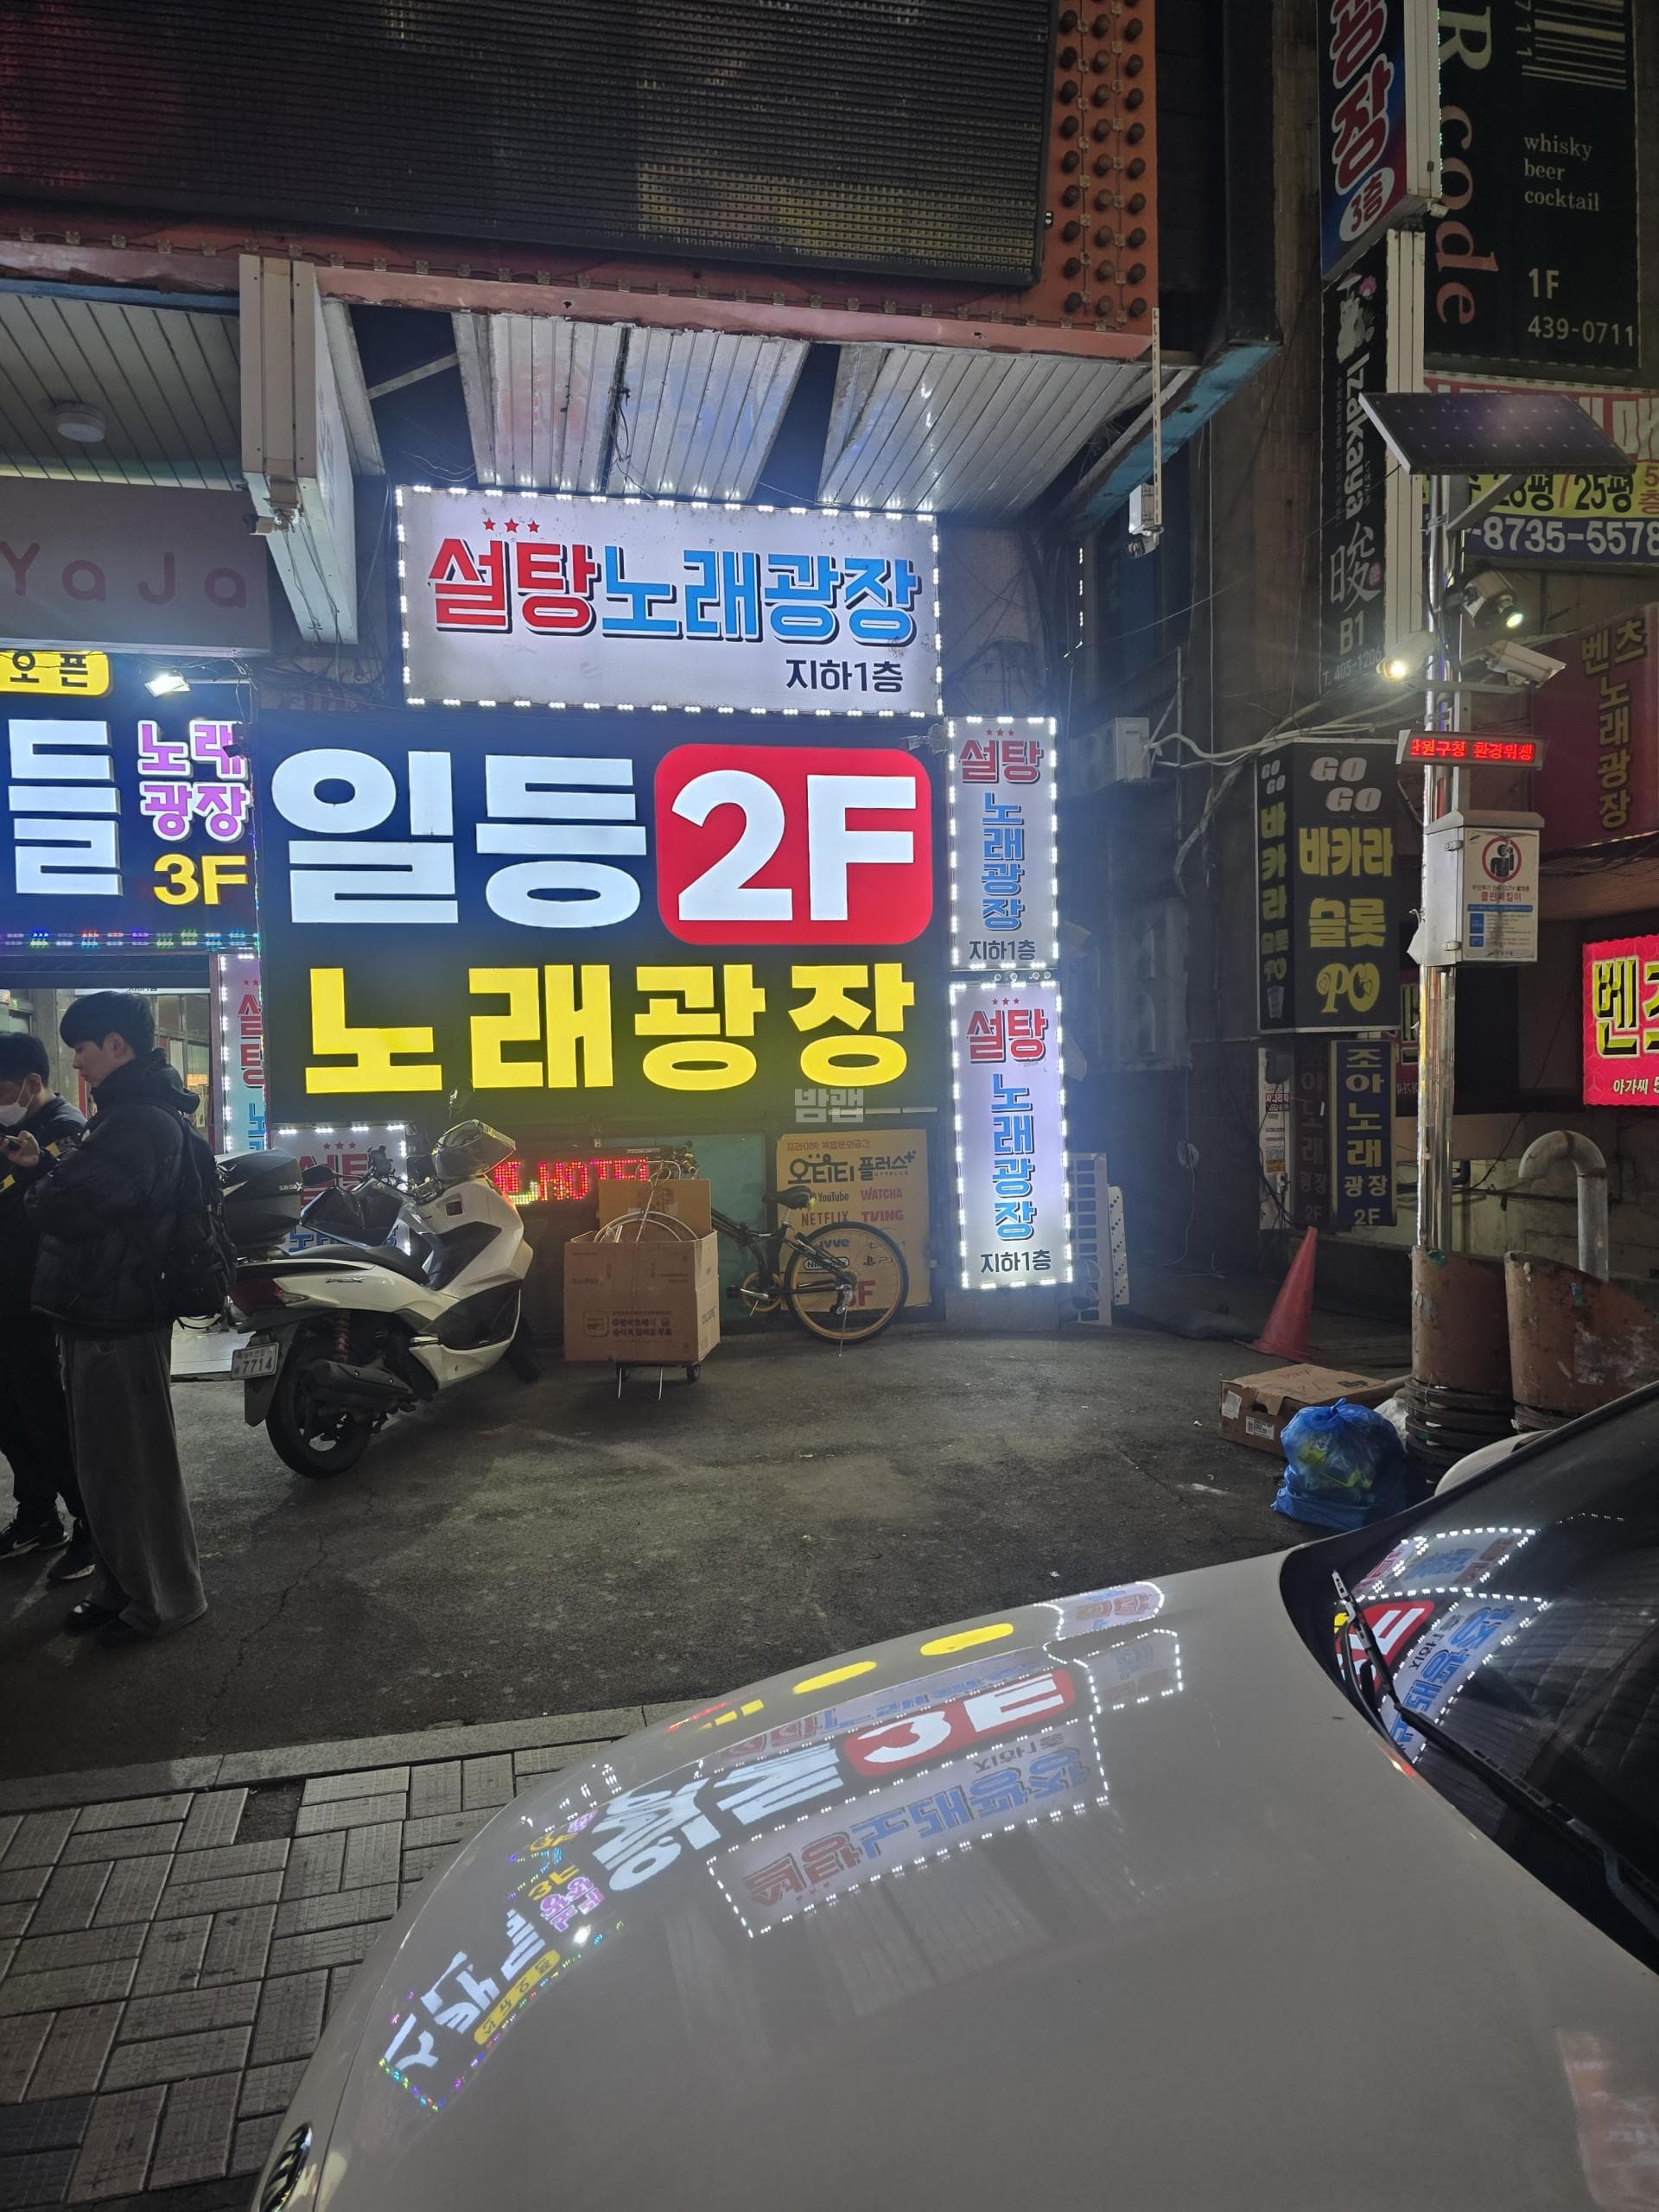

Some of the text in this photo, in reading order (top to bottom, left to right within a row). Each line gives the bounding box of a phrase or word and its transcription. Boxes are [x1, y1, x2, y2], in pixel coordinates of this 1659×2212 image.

[1523, 133, 1592, 162] whisky
[1524, 159, 1565, 181] beer
[1435, 105, 1499, 325] code
[1524, 190, 1600, 213] cocktail
[1529, 268, 1560, 300] 1F
[1528, 315, 1633, 347] 439-0711
[429, 537, 922, 647] 설탕노래광장
[1340, 609, 1364, 655] B1
[1580, 618, 1645, 675] 벤츠
[10, 650, 90, 689] 오픈
[785, 658, 904, 694] 지하1층
[137, 720, 248, 780] 노래
[959, 739, 1044, 785] 설탕
[1262, 760, 1281, 779] GO
[1311, 756, 1368, 782] GO
[1472, 741, 1535, 762] 환경위생
[1598, 675, 1631, 830] 노래광장
[9, 719, 121, 896] 들
[1267, 775, 1286, 794] GO
[1325, 786, 1382, 812] GO
[139, 780, 250, 842] 광장
[271, 748, 647, 929] 일등
[671, 769, 917, 922] 2F
[982, 791, 1027, 932] 노래광장
[1261, 801, 1287, 921] 바카라
[1299, 826, 1394, 877] 바카라
[153, 853, 249, 906] 3F
[1309, 898, 1387, 948] 슬롯
[969, 939, 1036, 961] 지하1층
[305, 963, 916, 1095] 노래광장
[966, 1007, 1048, 1064] 설탕
[1613, 1076, 1649, 1095] 아가씨
[991, 1073, 1039, 1242] 노래광장
[802, 1209, 905, 1227] NETFLIX TVING
[818, 1187, 903, 1203] YouTube WATCHA
[1354, 1209, 1381, 1225] 2F
[980, 1249, 1052, 1274] 지하1층
